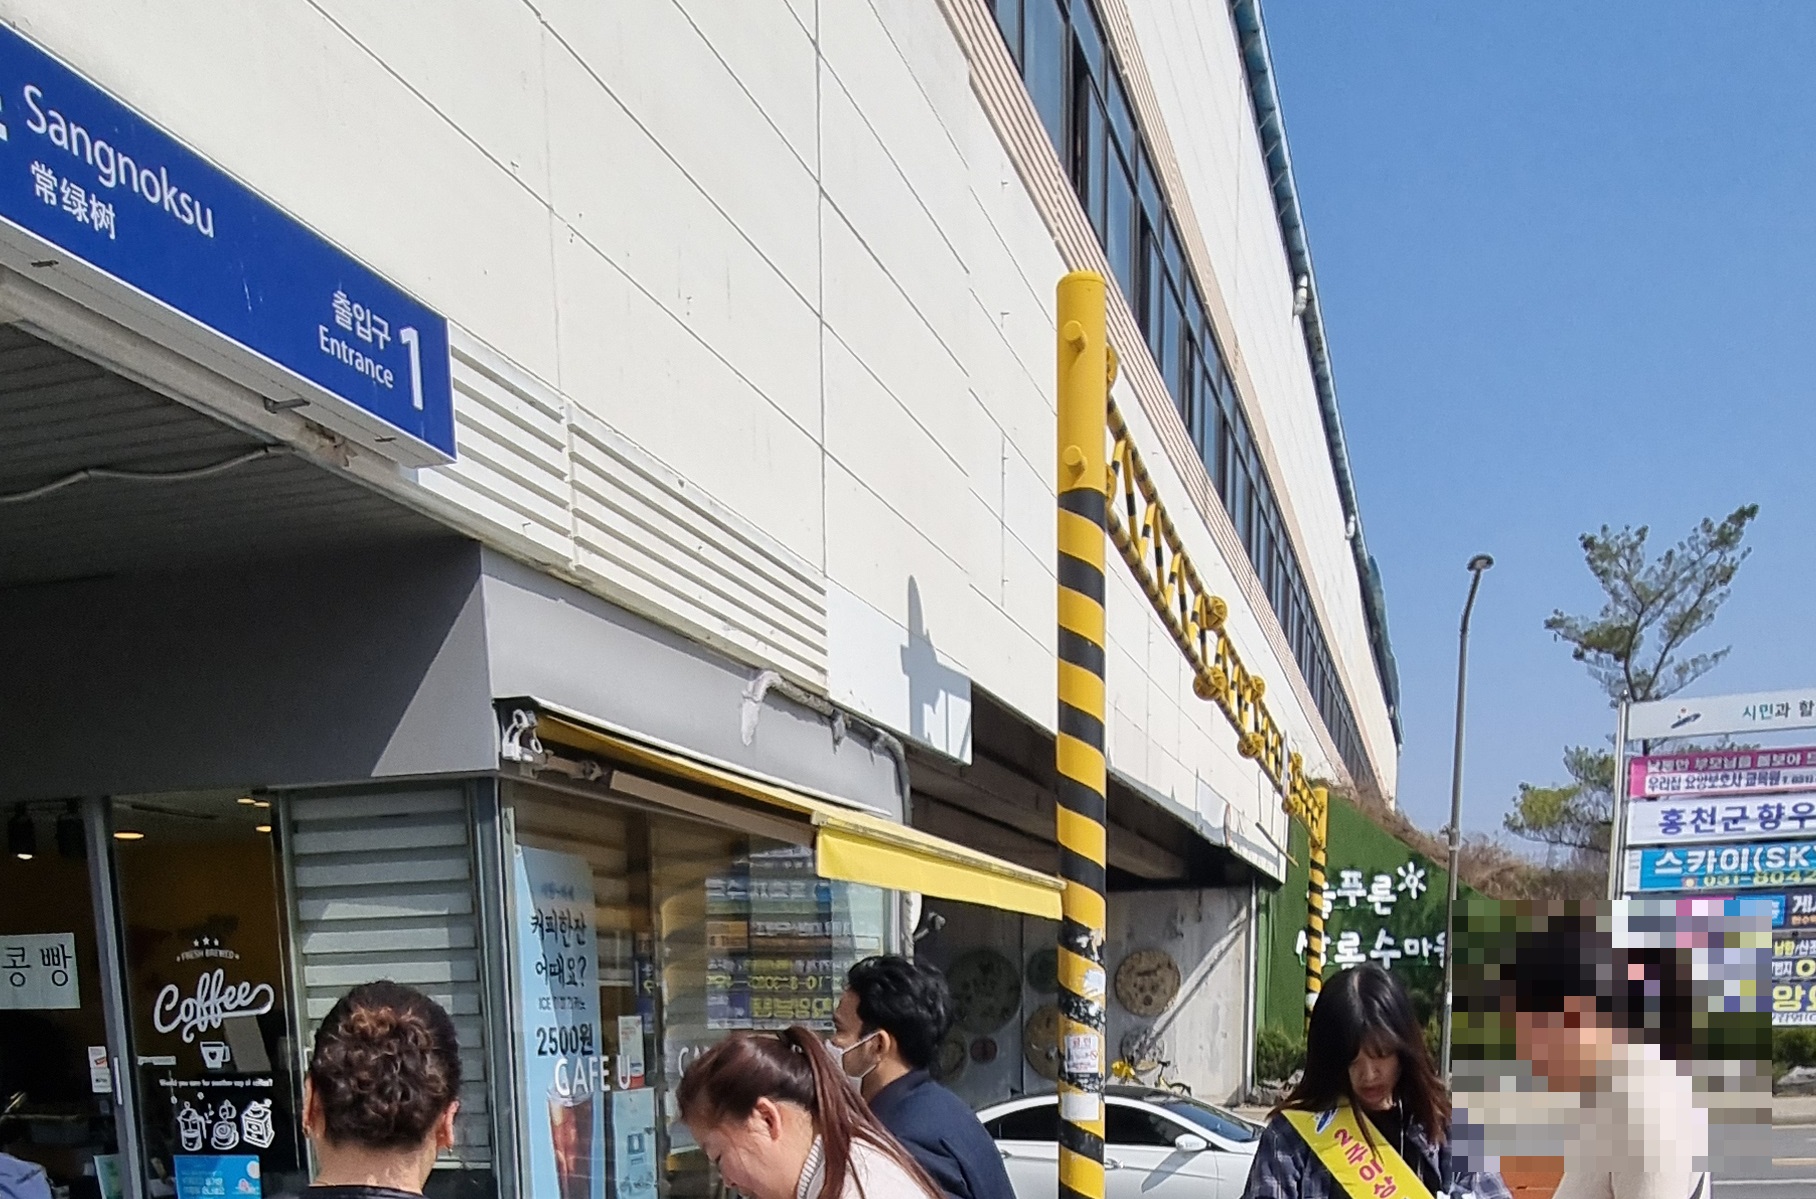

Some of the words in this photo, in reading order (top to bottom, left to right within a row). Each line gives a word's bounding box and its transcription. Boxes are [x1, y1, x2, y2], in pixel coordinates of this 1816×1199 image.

[24, 85, 215, 238] Sangnoksu
[31, 160, 117, 240] 常绿树
[331, 290, 392, 350] 출입구
[319, 325, 394, 389] Entrance
[400, 326, 424, 411] 1
[1742, 702, 1791, 721] 시민과
[1658, 805, 1750, 836] 홍천군
[1757, 801, 1816, 831] 향우
[530, 908, 587, 948] 커피한잔
[535, 951, 588, 988] 어때요?
[153, 968, 275, 1044] Coffee
[536, 1022, 594, 1057] 2500원
[555, 1055, 612, 1097] CAFE
[1333, 1128, 1397, 1199] 2주이상
